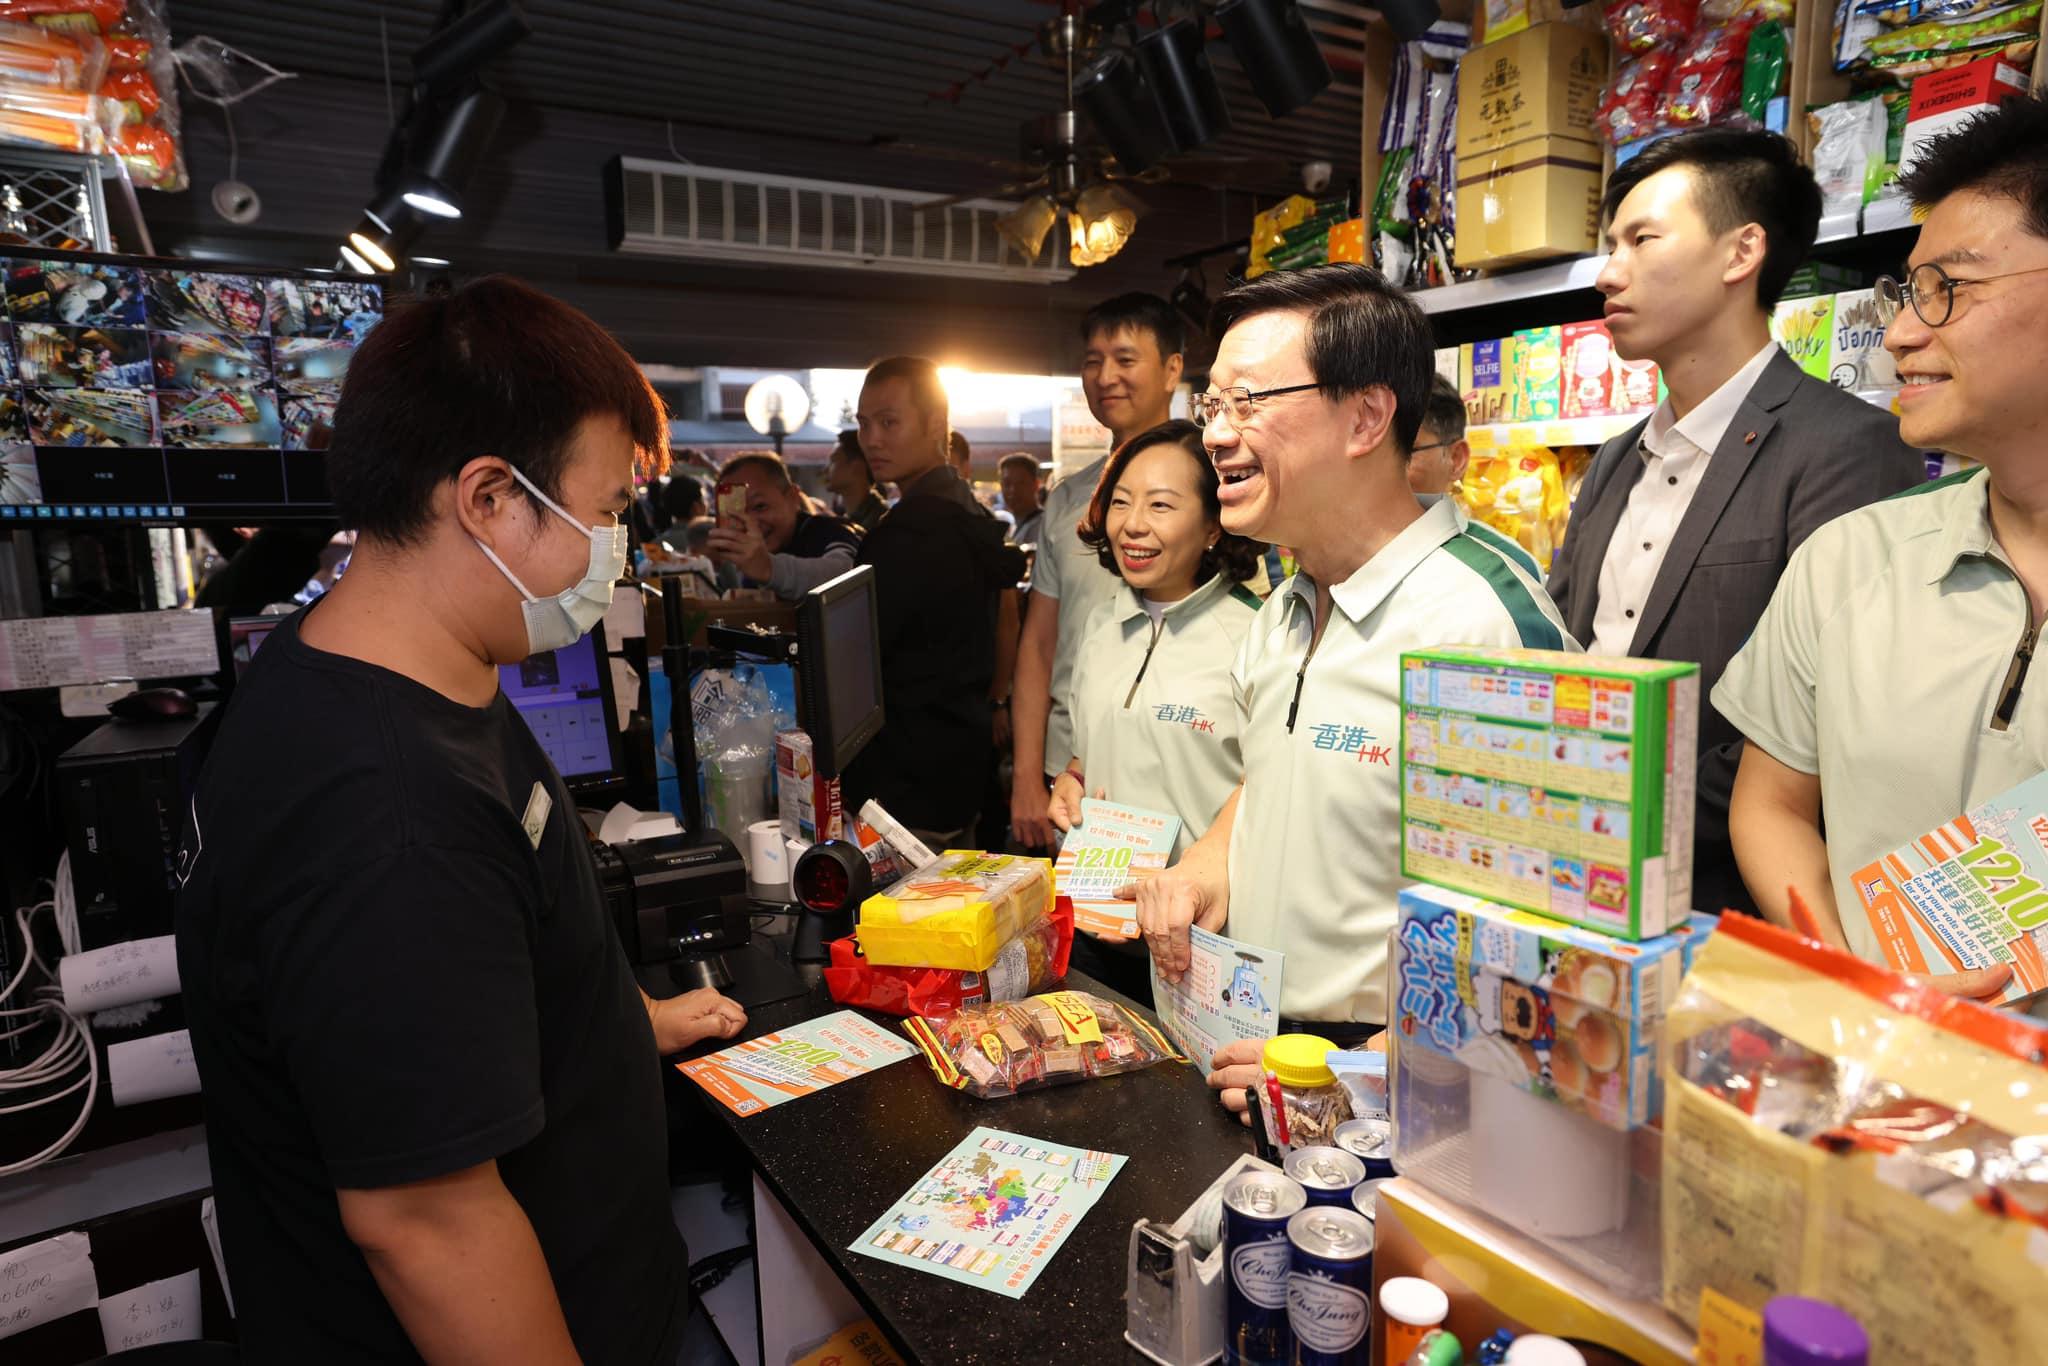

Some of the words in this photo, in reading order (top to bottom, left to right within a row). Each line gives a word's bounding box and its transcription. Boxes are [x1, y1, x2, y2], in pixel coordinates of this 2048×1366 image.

[1474, 362, 1501, 376] SELFIE
[1152, 703, 1206, 724] 香港
[1190, 719, 1216, 734] HK
[1309, 723, 1377, 753] 香港
[1357, 745, 1393, 766] HK
[1074, 847, 1133, 869] 1210
[1958, 836, 2048, 929] 1210
[1904, 883, 1914, 894] for
[1918, 899, 1939, 923] better
[1937, 923, 1975, 966] community
[1913, 877, 1930, 895] Cast
[1927, 894, 1945, 912] your
[1942, 912, 1959, 930] vote
[1957, 930, 1968, 939] at
[1965, 940, 1979, 951] DC
[1975, 952, 1991, 968] elec
[1924, 870, 2014, 963] 共建美好社區
[1940, 860, 2018, 940] 區選齊投票
[1403, 921, 1434, 1024] ミルク
[771, 1039, 842, 1065] 1210
[1239, 1256, 1288, 1281] CheJ
